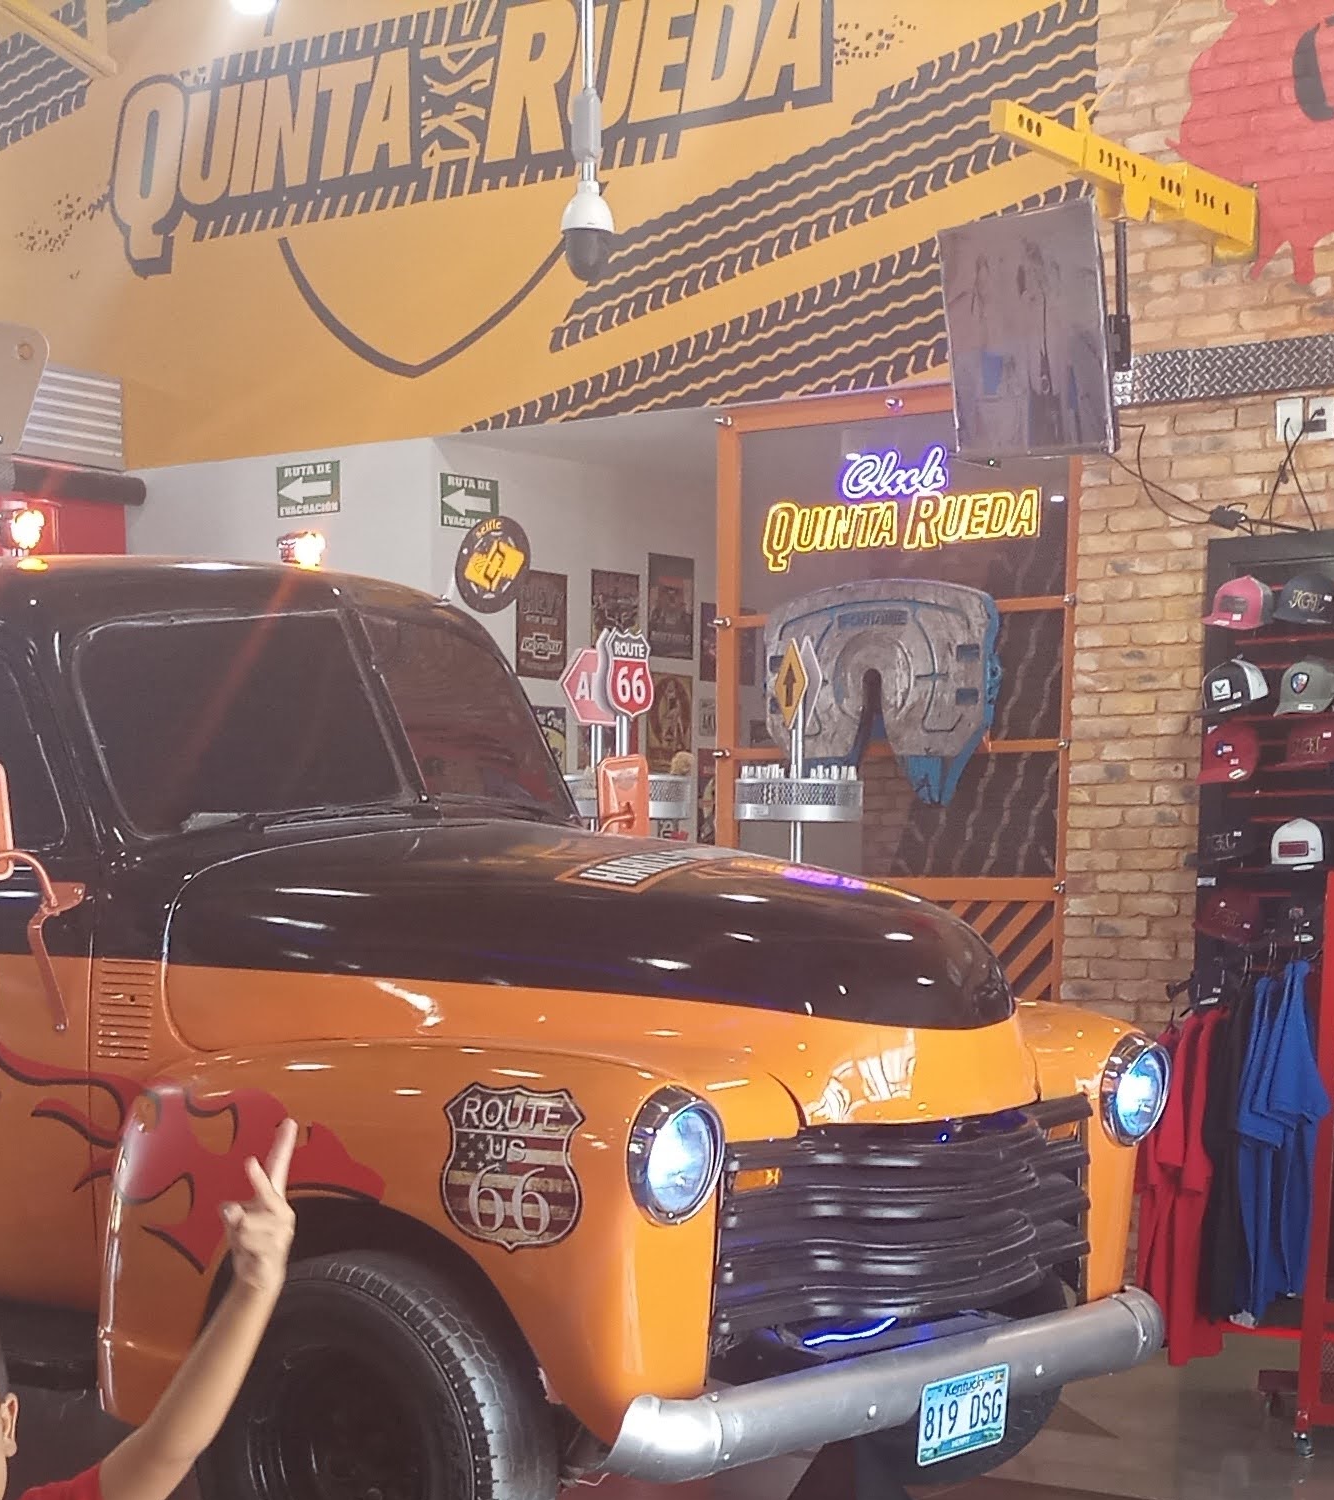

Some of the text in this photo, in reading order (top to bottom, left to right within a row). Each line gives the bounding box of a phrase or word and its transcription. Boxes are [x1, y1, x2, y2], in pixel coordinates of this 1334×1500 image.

[114, 0, 825, 262] QUINTA RUEDA
[284, 462, 332, 478] RUTA DE
[447, 475, 492, 492] RUTA DE
[843, 447, 949, 496] Club
[279, 499, 340, 517] EVACUACIÓN
[763, 488, 1041, 573] QUINTA RUEDA
[614, 641, 646, 658] ROUTE
[616, 666, 647, 704] 66
[460, 1100, 565, 1131] ROUTE
[487, 1136, 527, 1164] US
[467, 1167, 552, 1237] 66
[945, 1375, 986, 1397] Kentucky
[924, 1388, 1003, 1441] 819 DSG
